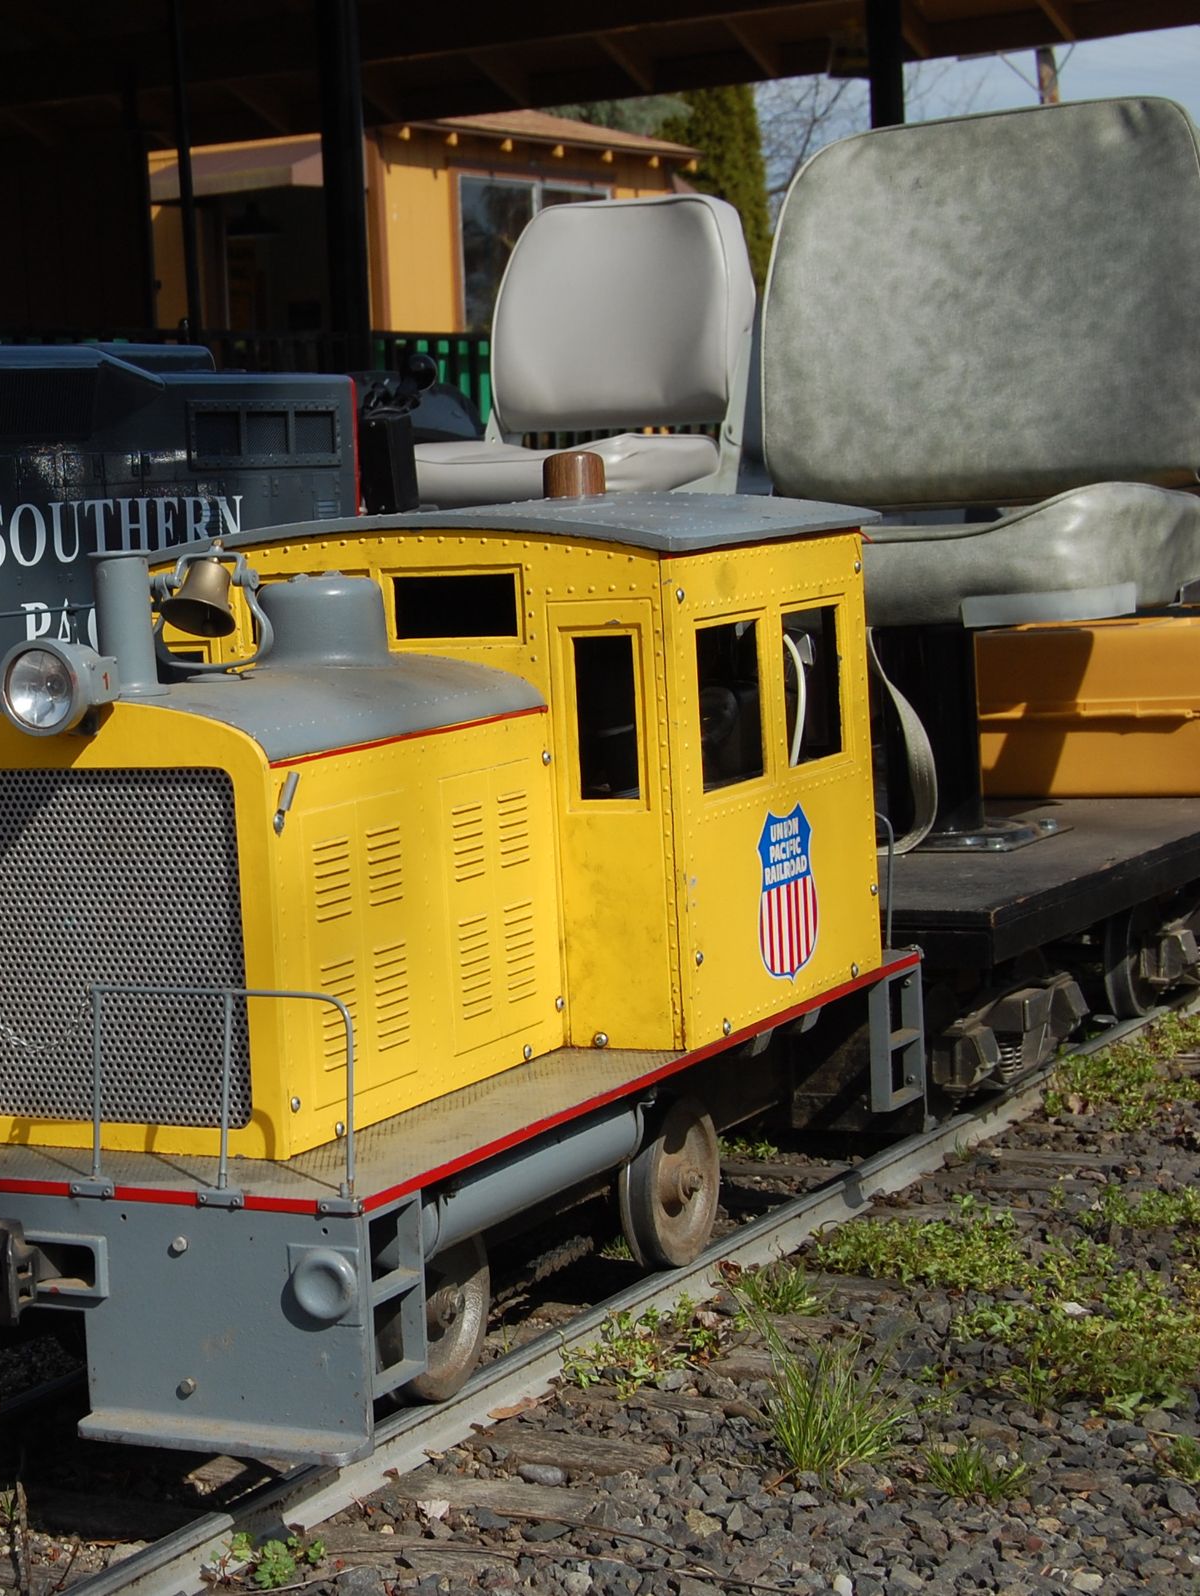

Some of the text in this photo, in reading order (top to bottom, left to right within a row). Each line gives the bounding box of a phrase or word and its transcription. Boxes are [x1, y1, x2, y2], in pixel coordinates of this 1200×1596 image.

[102, 671, 109, 690] 1
[770, 817, 799, 843] UNION
[769, 836, 802, 864] PACIFIC
[764, 854, 808, 886] RAILROAD
